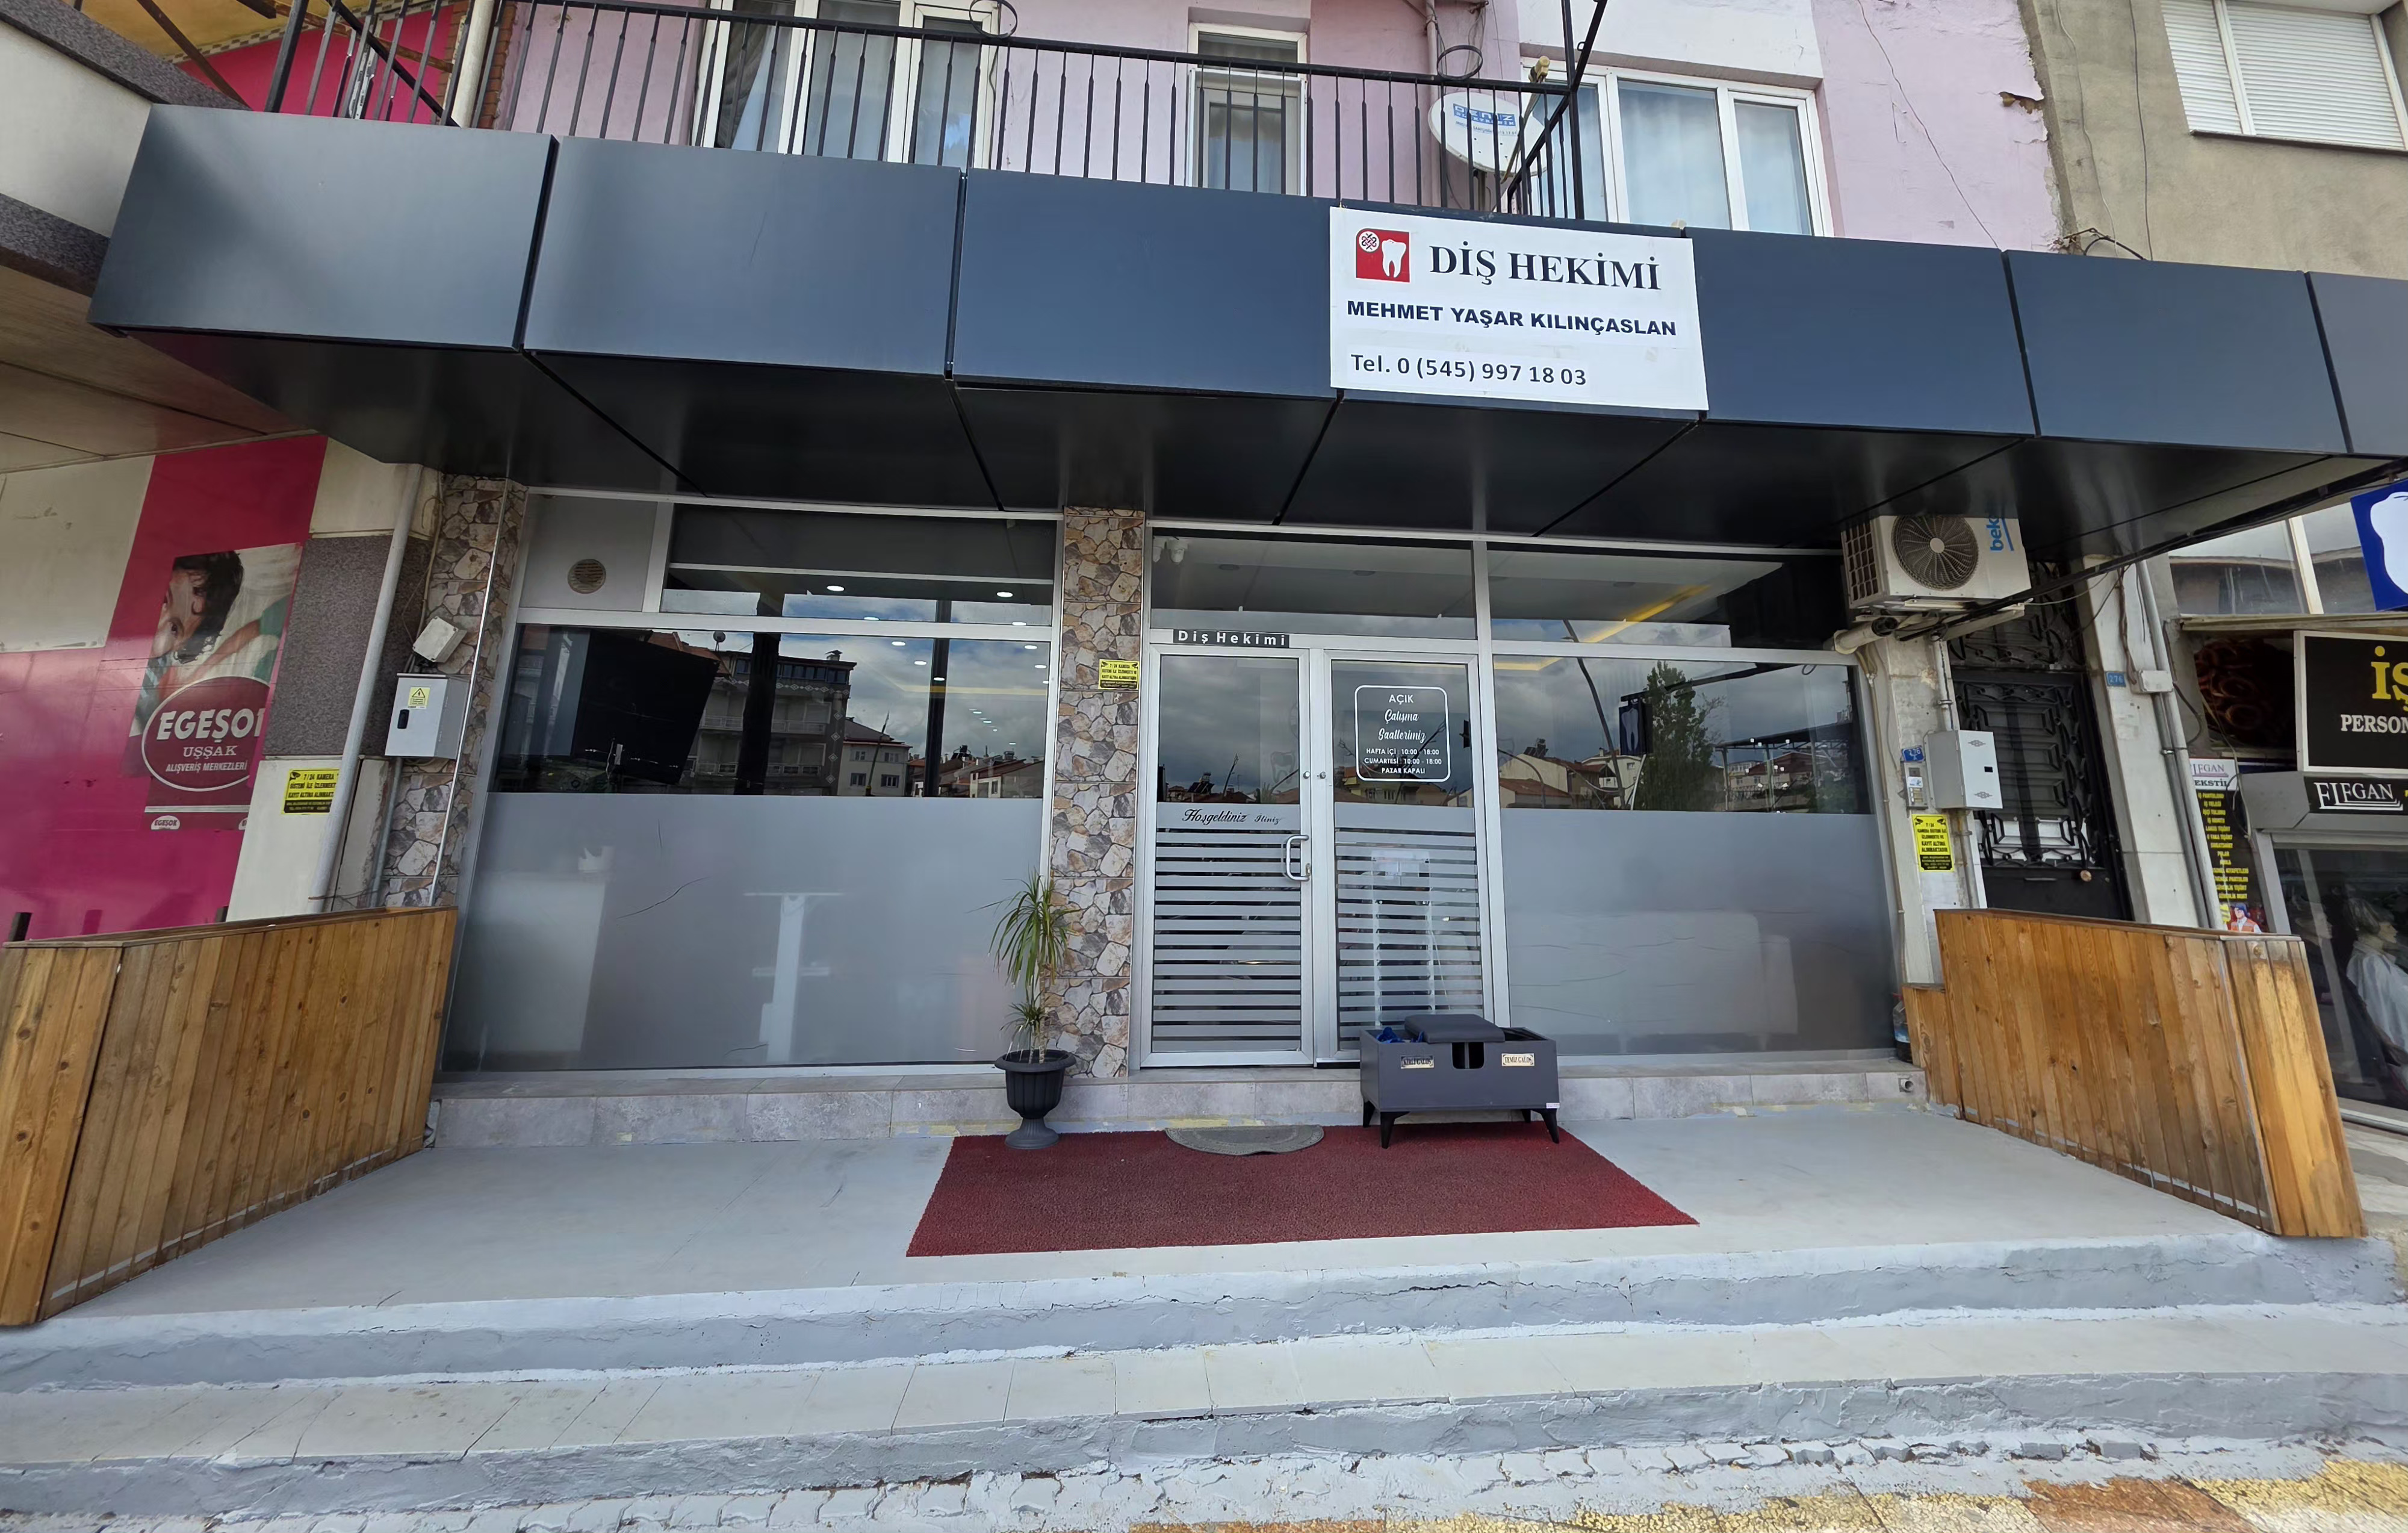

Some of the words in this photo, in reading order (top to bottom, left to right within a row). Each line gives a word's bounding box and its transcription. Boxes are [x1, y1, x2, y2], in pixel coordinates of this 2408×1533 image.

[1429, 241, 1497, 285] DİŞ
[1508, 252, 1662, 290] HEKİMİ
[1347, 300, 1444, 322] MEHMET
[1451, 307, 1523, 329] YAŞAR
[1531, 313, 1677, 336] KILINÇASLAN
[1351, 353, 1391, 373] Tel.
[1397, 357, 1410, 375] 0
[1417, 357, 1476, 382] (545)
[1482, 364, 1521, 382] 997
[1530, 365, 1554, 384] 18
[1560, 368, 1587, 386] 03
[1986, 517, 2004, 551] bek
[1178, 630, 1208, 644] Diş
[1217, 632, 1285, 646] Hekimi
[1389, 694, 1413, 705] AÇIK
[1385, 709, 1420, 724] Çalışma
[183, 745, 238, 760] UŞŞAK
[1387, 747, 1396, 756] İÇİ
[166, 761, 202, 774] ALIŞVERİŞ
[202, 759, 249, 771] MERKEZLERİ
[2192, 763, 2229, 777] LEGAN
[2194, 778, 2230, 787] EKSTİL
[1182, 808, 1249, 826] Hoşgeldiniz
